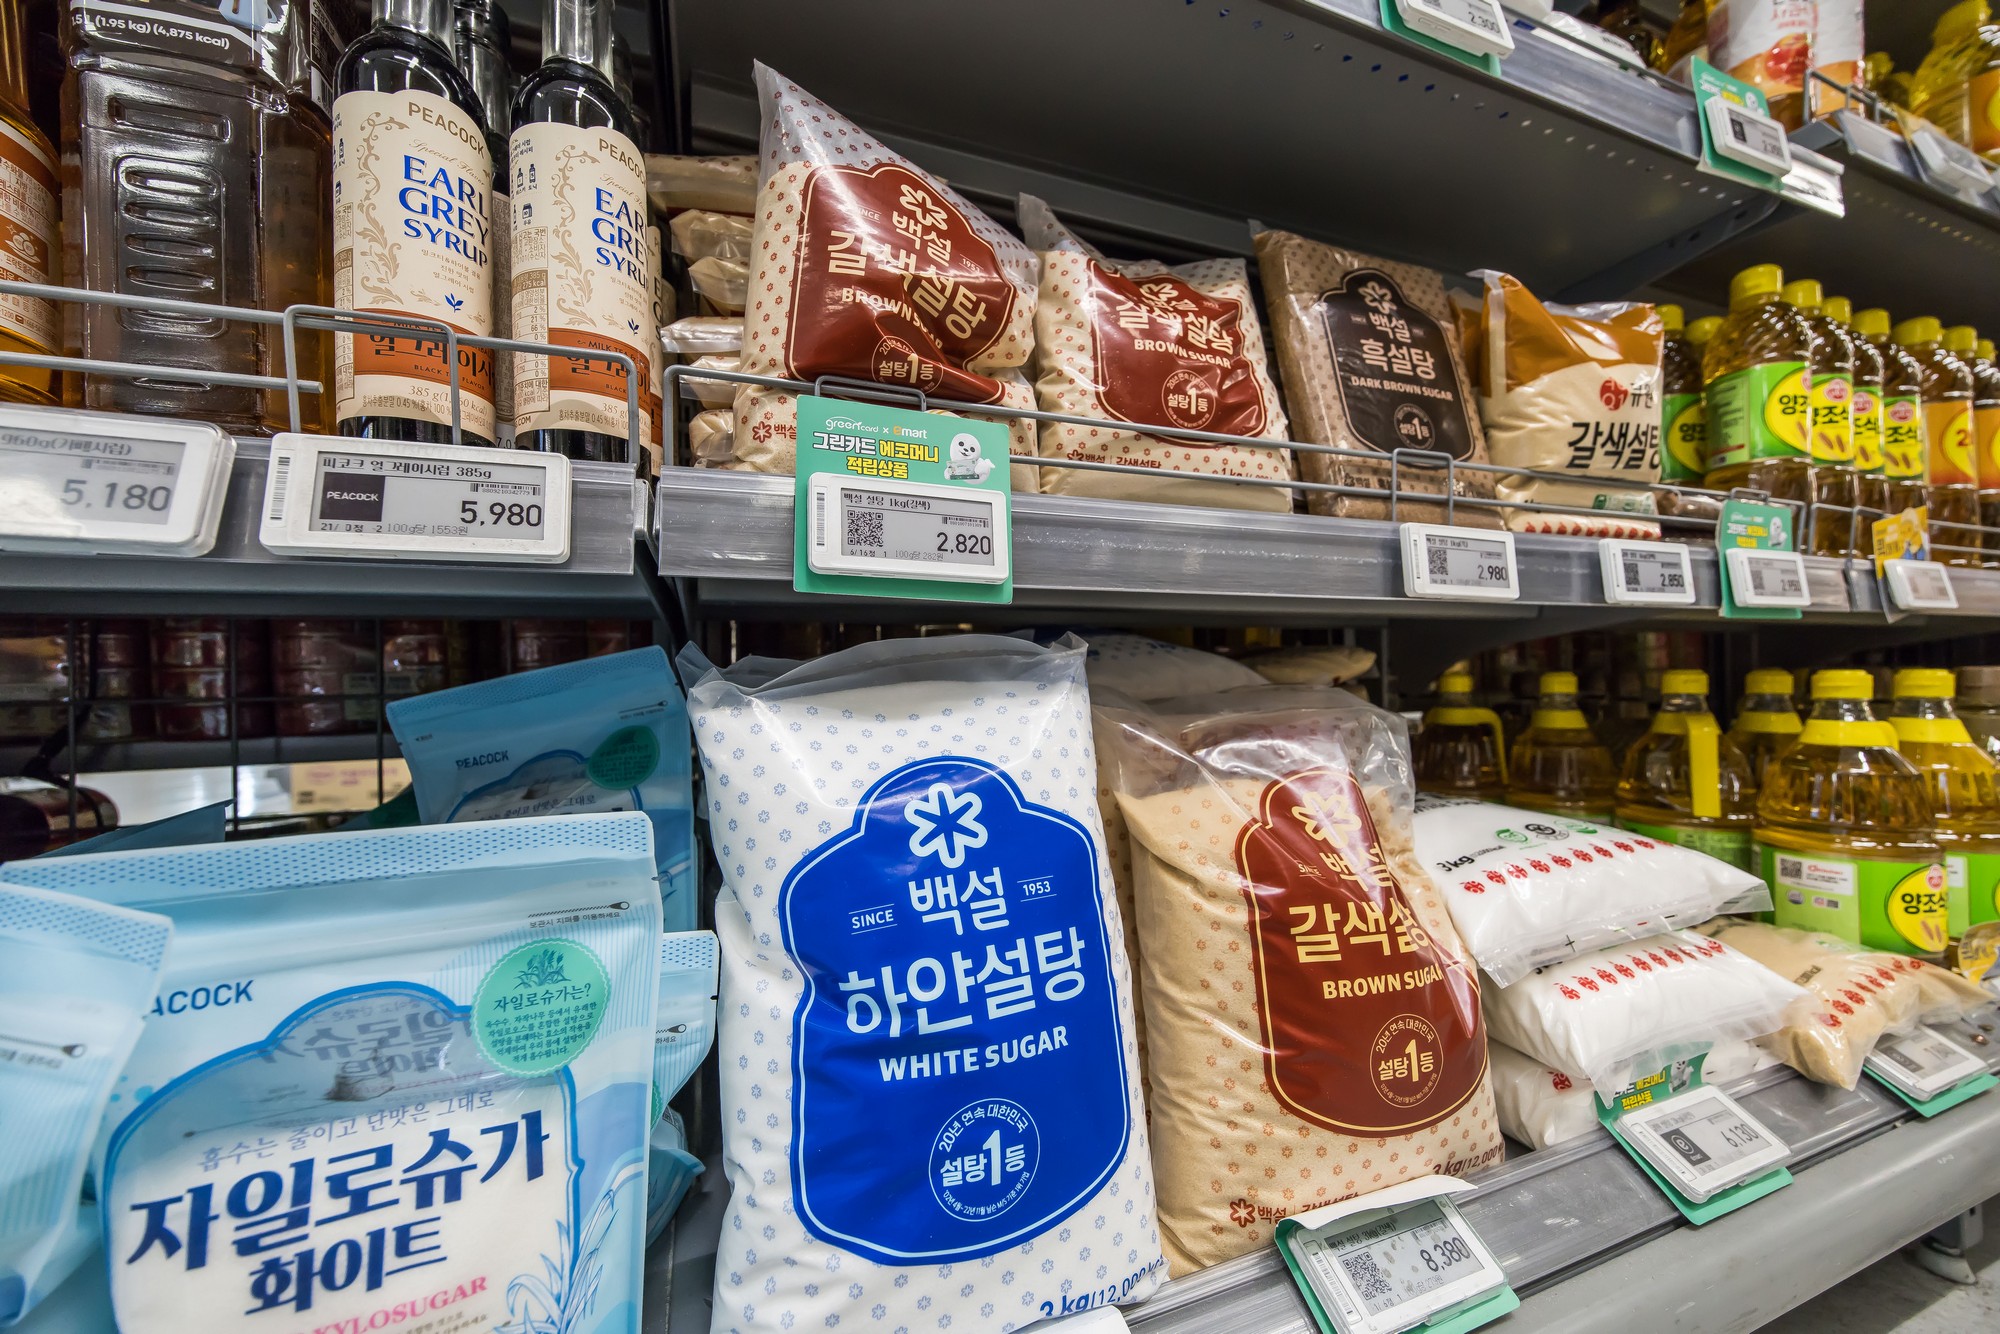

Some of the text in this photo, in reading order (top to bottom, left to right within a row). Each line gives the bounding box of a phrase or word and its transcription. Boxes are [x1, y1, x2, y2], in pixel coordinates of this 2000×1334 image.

[95, 14, 230, 49] (1.95 kg) (4,875 kcal)
[408, 101, 485, 159] PEACOCK
[409, 138, 456, 164] Special
[403, 154, 489, 221] EARL
[600, 172, 634, 196] Special
[398, 187, 489, 247] GREY
[403, 218, 488, 269] SYRUP
[892, 210, 953, 268] 백설
[841, 287, 913, 321] BROWN
[1369, 311, 1412, 343] 백설
[588, 340, 611, 352] MILK
[1134, 338, 1232, 369] BROWN SUGAR
[1360, 338, 1436, 380] 흑설탕
[414, 364, 442, 377] BLACK
[462, 377, 485, 391] FLAVOR
[408, 385, 430, 398] 385
[605, 384, 627, 393] BLACK
[1350, 376, 1454, 402] DARK BROWN SUGAR
[434, 403, 445, 414] 100
[826, 416, 879, 434] greencard
[893, 425, 928, 440] emart
[813, 432, 940, 463] 그린카드 에코머니
[322, 457, 492, 480] 피코크 얼그레이시럽 385g
[846, 456, 909, 479] 적립상품
[61, 478, 171, 511] 5,180
[327, 491, 379, 501] PEACOCK
[844, 493, 862, 504] 백설
[460, 500, 542, 527] 5,980
[937, 532, 991, 555] 2,820
[1478, 564, 1508, 581] 2,980
[455, 750, 509, 771] PEACOCK
[908, 866, 1010, 936] 백설
[1022, 880, 1051, 897] 1953
[530, 911, 621, 929] 보관시 지퍼를 이용하세요
[851, 909, 894, 930] SINCE
[839, 926, 1086, 1038] 하얀설탕
[1322, 973, 1401, 1000] BROWN
[494, 982, 592, 1013] 자일로슈가는?
[1375, 1018, 1435, 1054] 20년 연속 대한민국
[879, 1025, 1069, 1082] WHITE SUGAR
[200, 1089, 495, 1173] 흡수는 줄이고 단맛은 그대로
[938, 1103, 1029, 1153] 20년 연속 대한민국
[1720, 1123, 1760, 1149] 6,130
[127, 1110, 550, 1271] 자일로슈가
[1257, 1205, 1287, 1225] 백설
[244, 1215, 448, 1317] 화이트
[1419, 1236, 1471, 1273] 8,380
[313, 1275, 488, 1334] XYLOSUGAR
